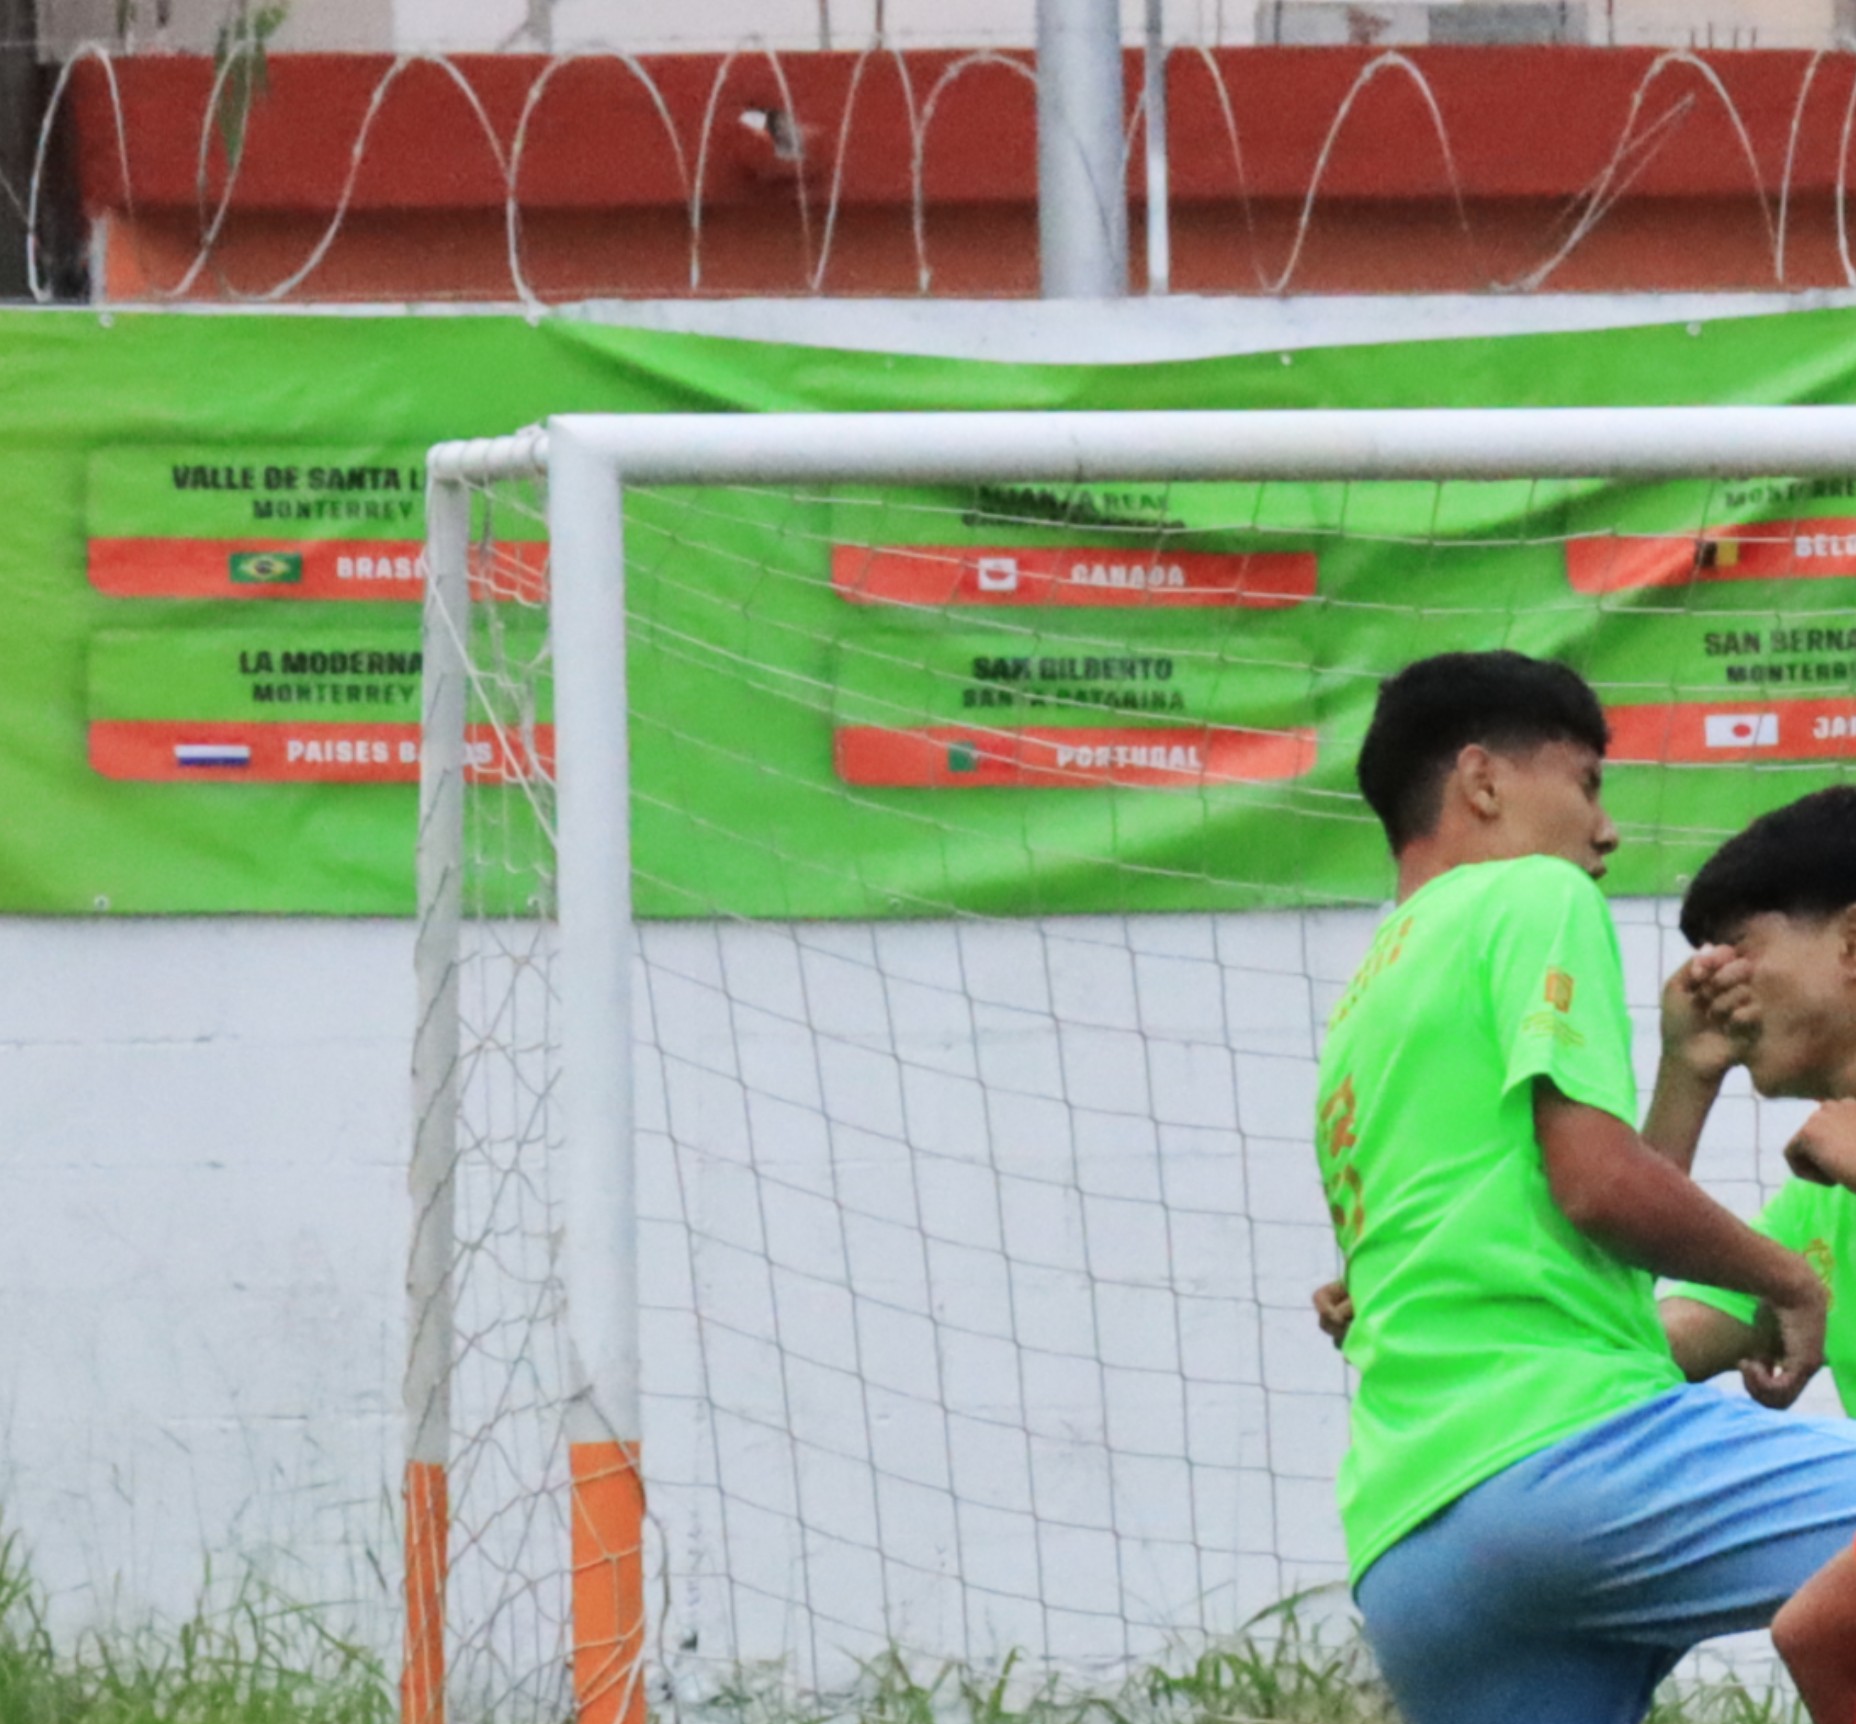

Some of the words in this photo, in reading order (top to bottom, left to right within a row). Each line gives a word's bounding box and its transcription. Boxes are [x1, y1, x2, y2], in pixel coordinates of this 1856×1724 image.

[171, 465, 255, 490] VALLE
[264, 466, 298, 490] DE
[307, 467, 400, 491] SANTA
[253, 500, 413, 519] MONTERREY
[1704, 630, 1760, 656] SAN
[240, 651, 273, 675] LA
[972, 656, 1031, 681] SAN
[253, 684, 415, 703] MONTERREY
[1057, 743, 1202, 768] PORTUGAL
